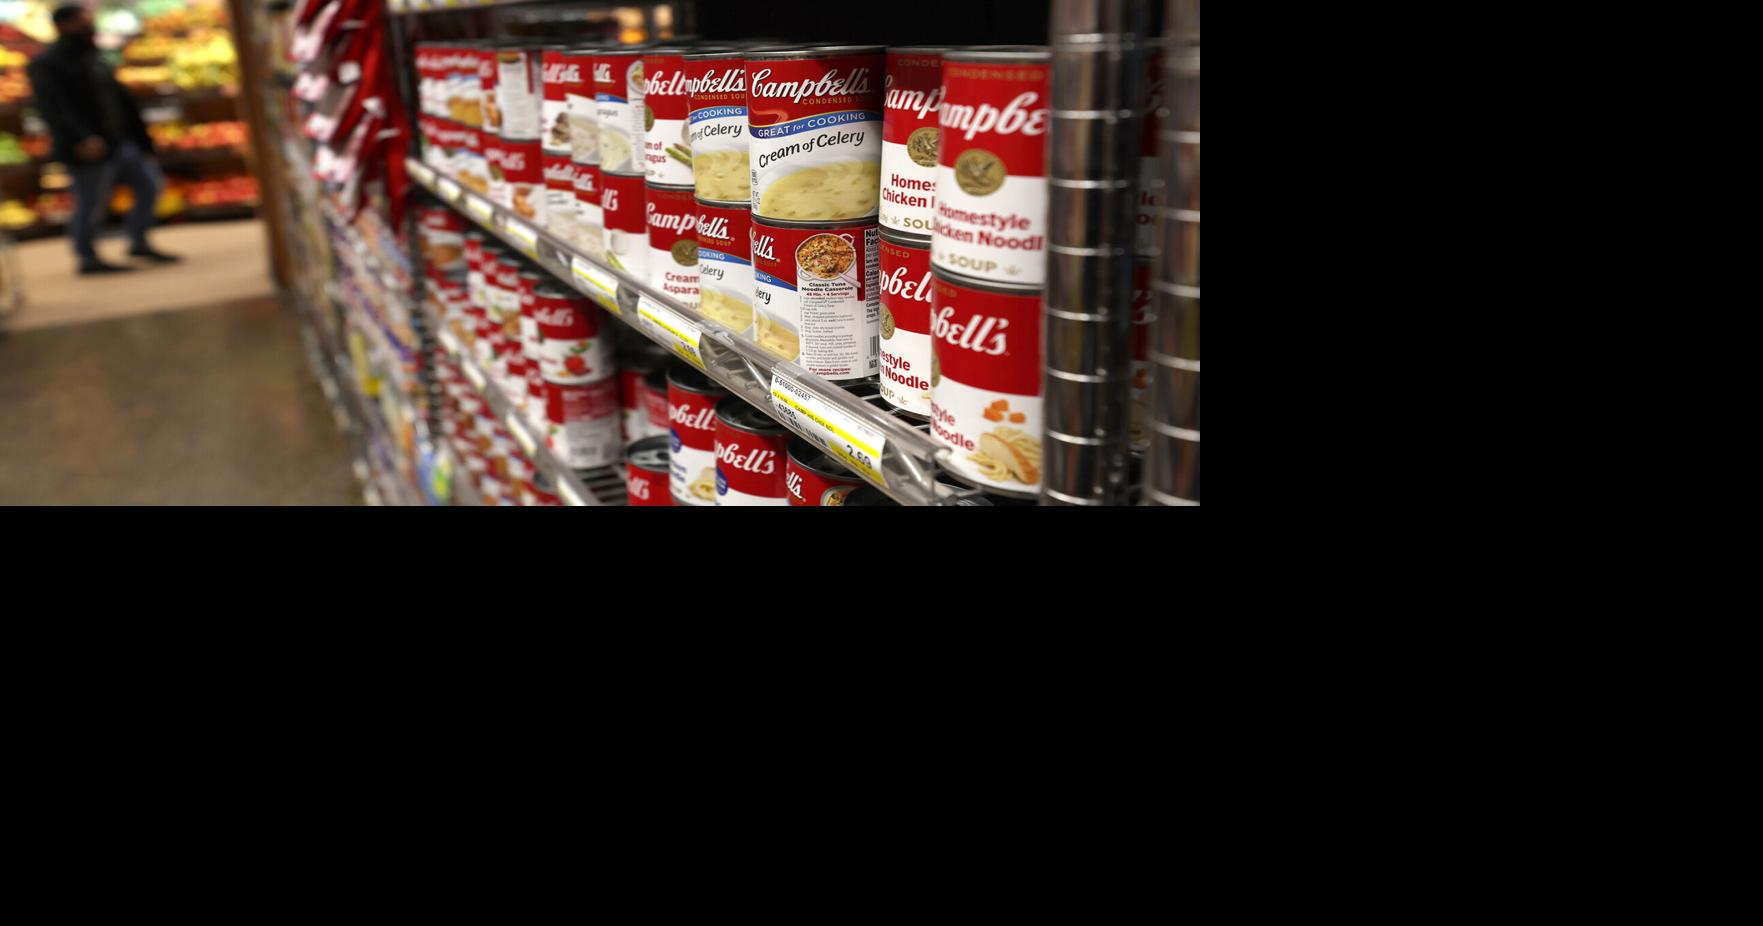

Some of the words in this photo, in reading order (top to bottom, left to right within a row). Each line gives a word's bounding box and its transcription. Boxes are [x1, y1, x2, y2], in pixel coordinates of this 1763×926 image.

[752, 68, 870, 103] Campbell's
[803, 97, 852, 105] CONDENSED
[697, 108, 742, 119] COOKING
[704, 123, 742, 137] Celery
[758, 125, 790, 138] GREAT
[793, 123, 804, 132] for
[807, 112, 865, 128] COOKING
[759, 144, 800, 168] Cream
[802, 138, 815, 152] of
[816, 131, 865, 147] Celery
[882, 187, 927, 208] Chicken
[949, 253, 998, 272] SOUP
[885, 365, 929, 390] Noodle
